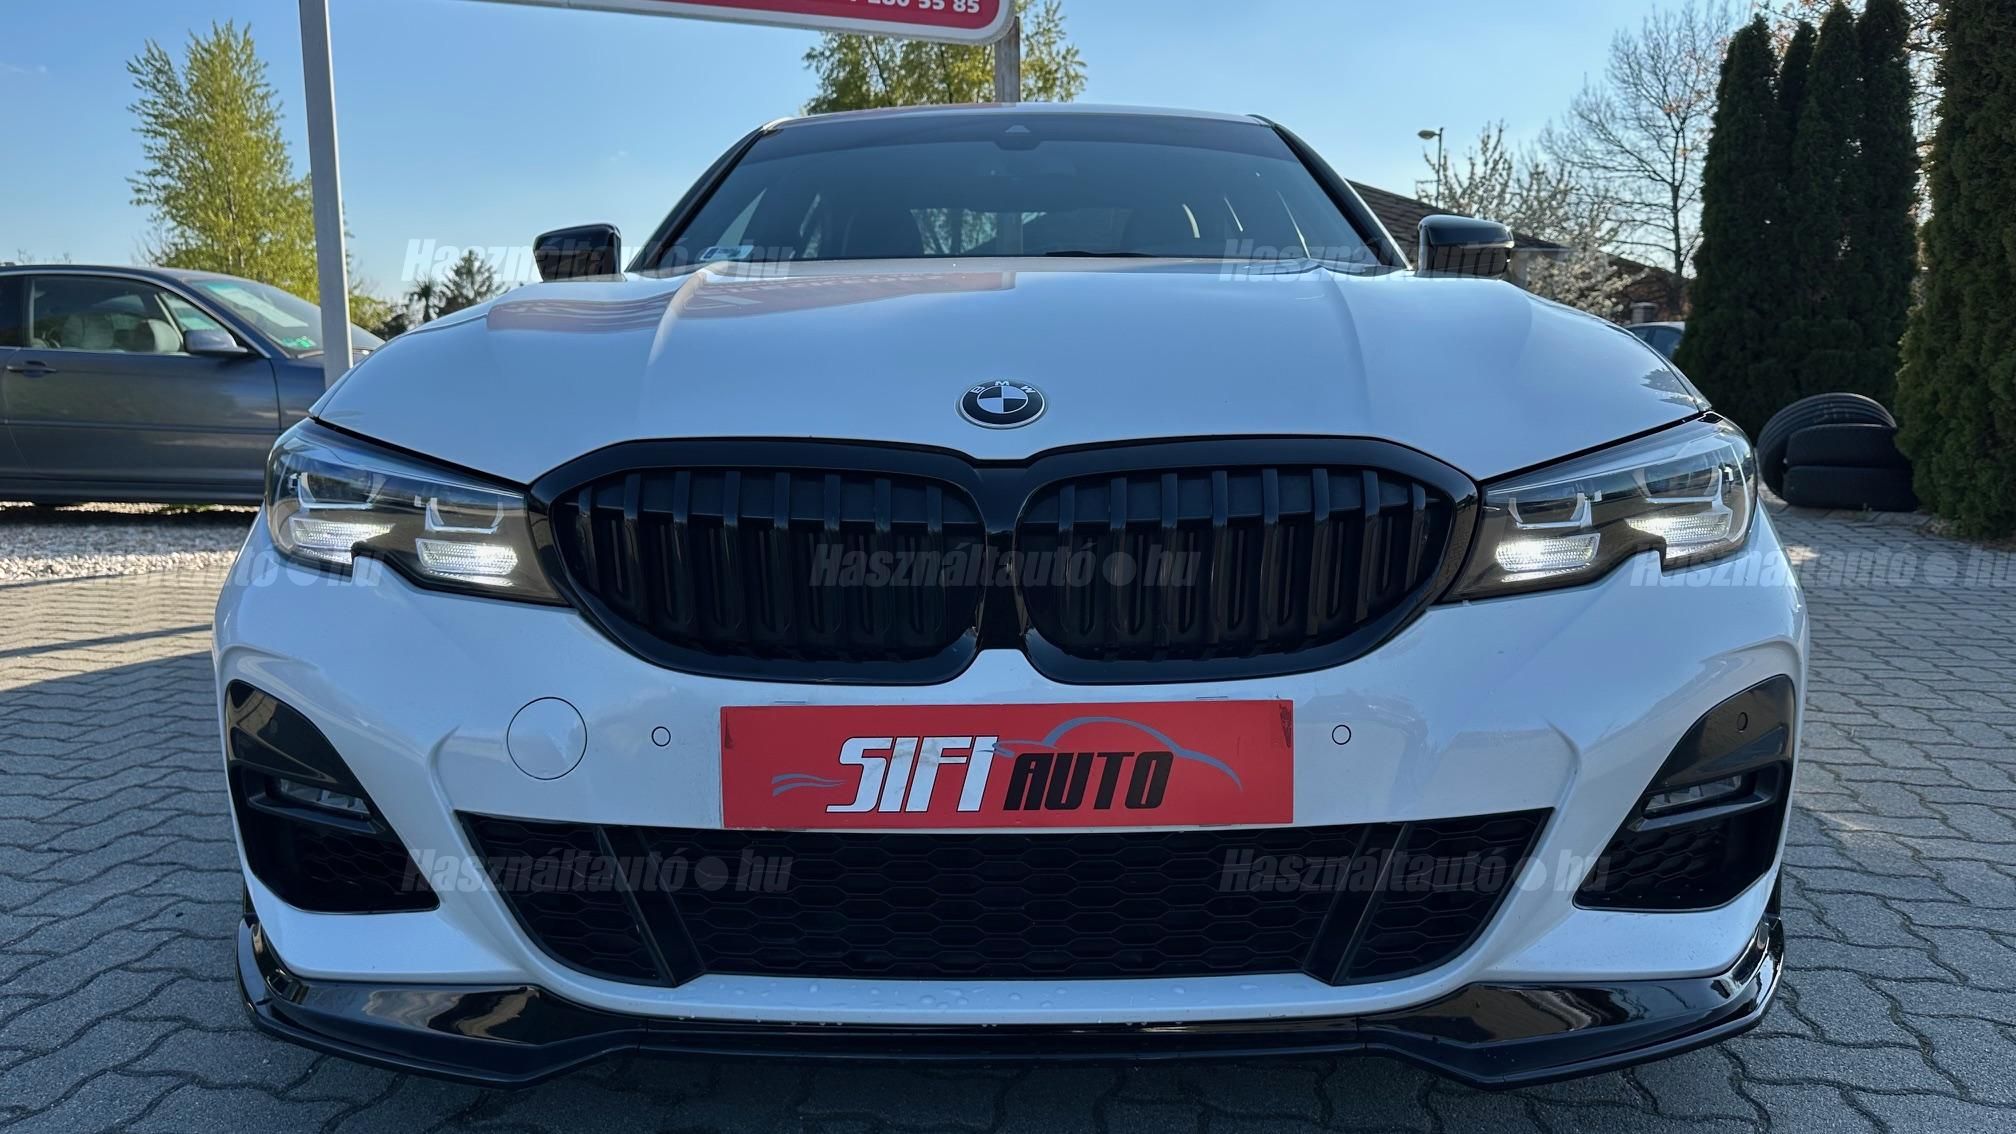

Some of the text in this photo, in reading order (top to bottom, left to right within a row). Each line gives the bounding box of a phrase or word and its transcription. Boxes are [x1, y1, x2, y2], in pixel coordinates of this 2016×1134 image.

[970, 380, 1036, 394] BMW
[826, 735, 1174, 813] SIFI AUTO
